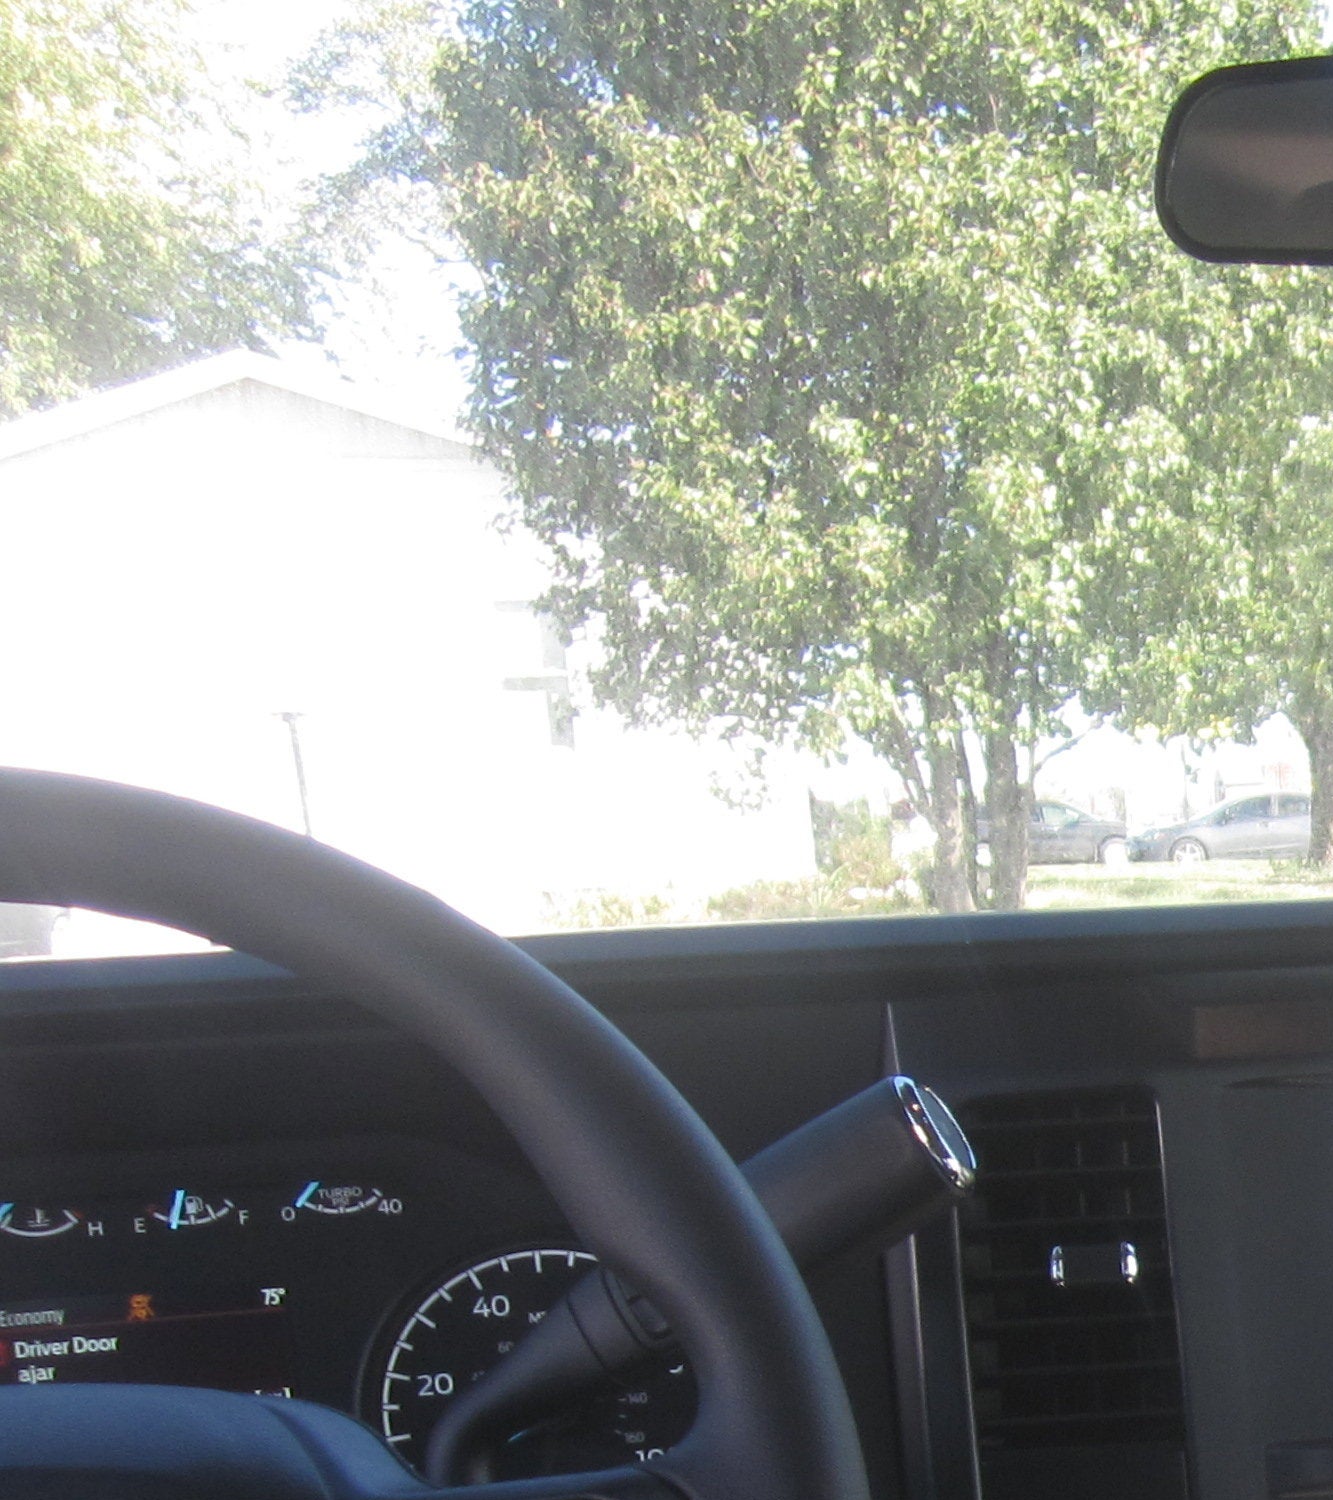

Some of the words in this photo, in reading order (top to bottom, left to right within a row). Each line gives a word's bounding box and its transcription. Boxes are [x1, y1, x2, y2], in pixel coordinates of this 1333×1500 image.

[317, 1187, 363, 1200] TURBO
[377, 1199, 403, 1215] 40
[134, 1217, 146, 1234] E
[239, 1210, 249, 1226] F
[88, 1221, 104, 1237] H
[472, 1295, 510, 1318] 40
[0, 1308, 65, 1327] Economy
[14, 1341, 69, 1359] Driver
[72, 1335, 119, 1355] Door
[18, 1366, 56, 1384] ajar
[417, 1372, 454, 1396] 20
